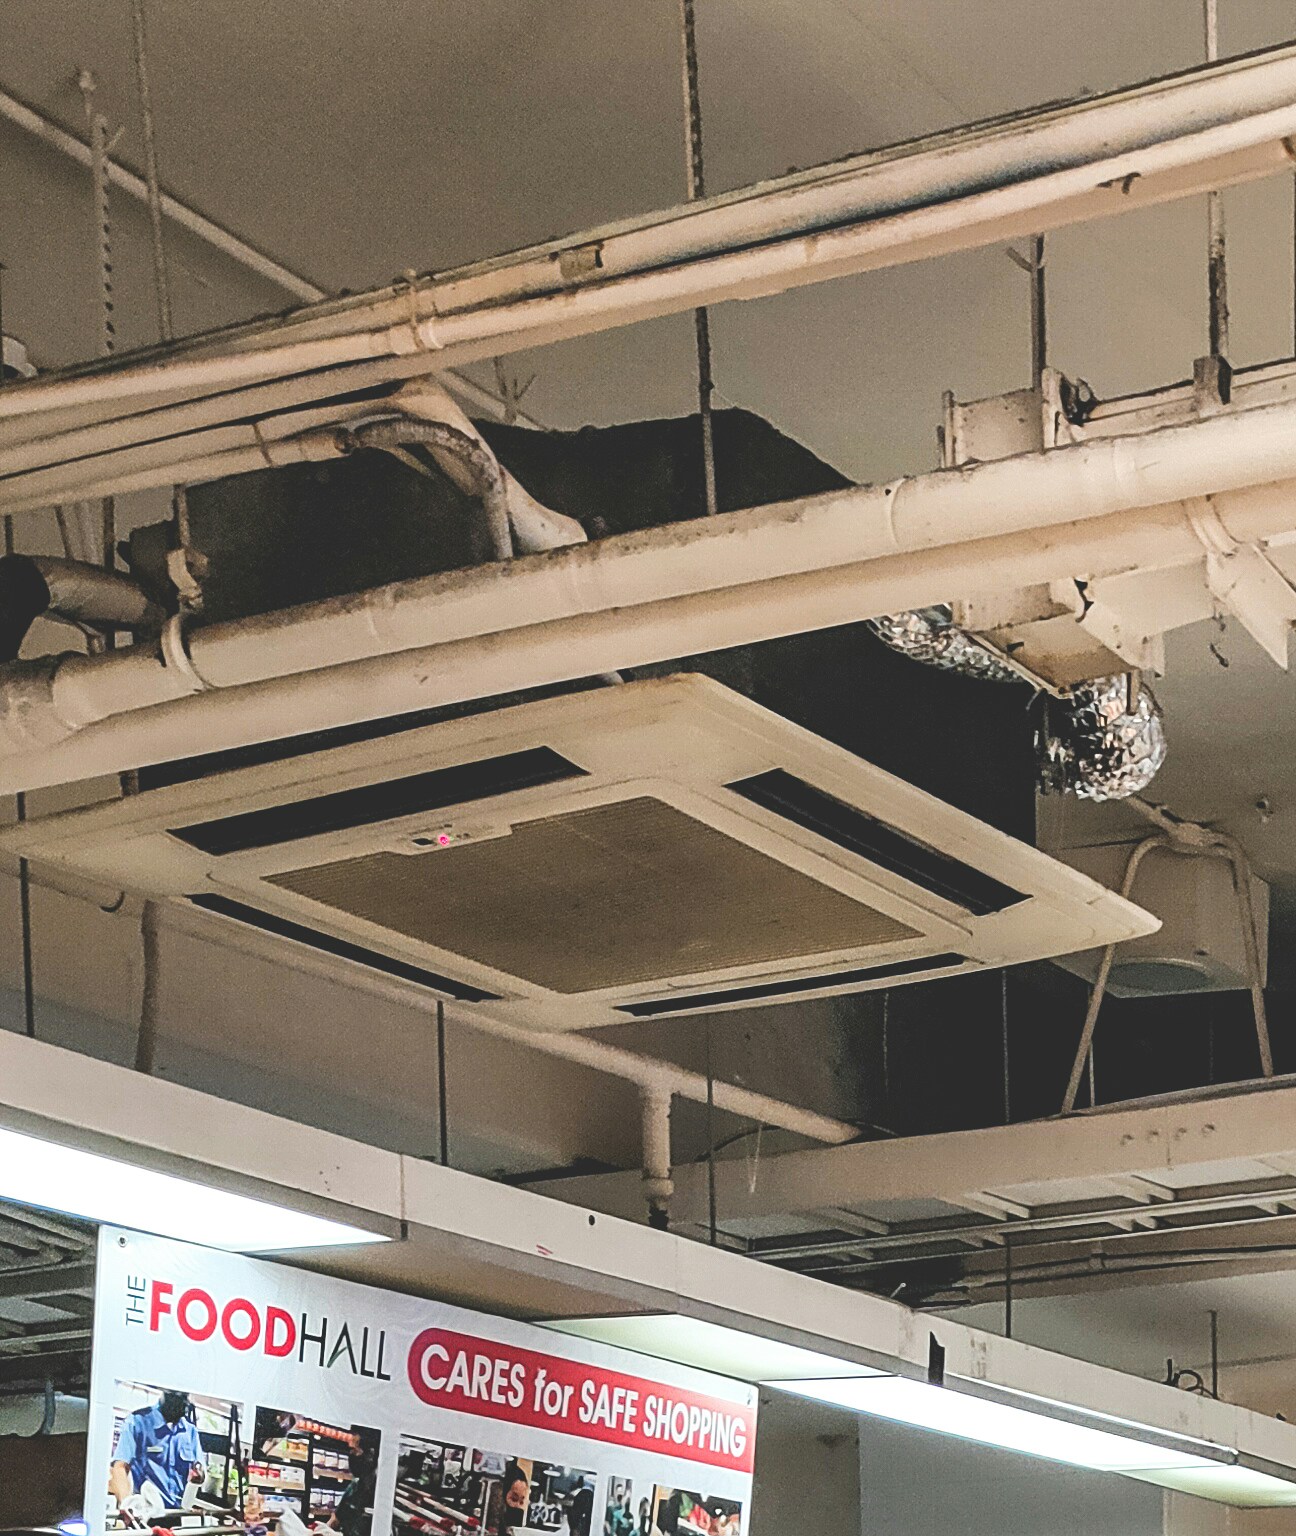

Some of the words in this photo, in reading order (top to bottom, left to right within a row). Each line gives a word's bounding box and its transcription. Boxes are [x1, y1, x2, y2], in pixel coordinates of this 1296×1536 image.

[126, 1275, 146, 1326] THE
[420, 1343, 525, 1410] CARES
[534, 1366, 571, 1418] for
[578, 1379, 637, 1433] SAFE
[643, 1392, 747, 1458] SHOPPING
